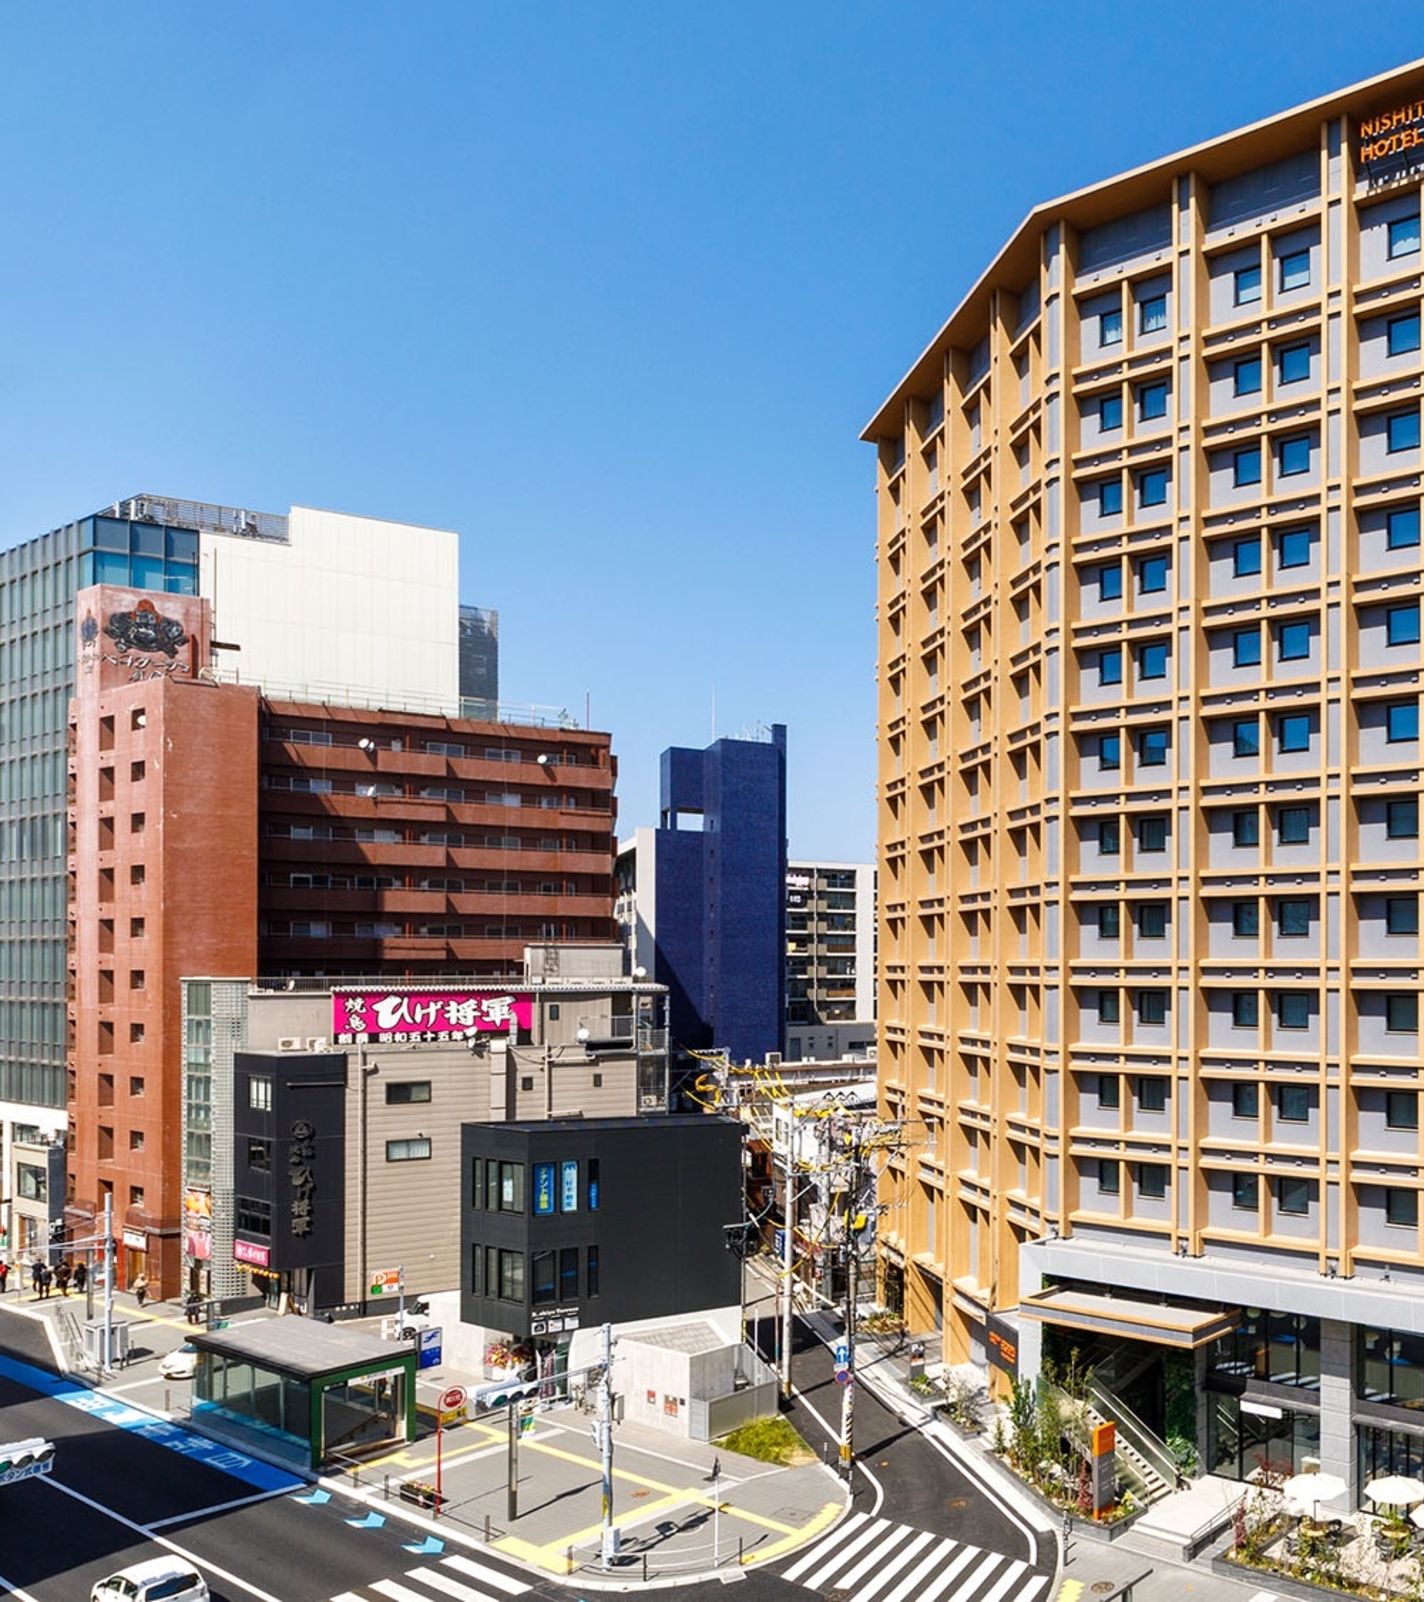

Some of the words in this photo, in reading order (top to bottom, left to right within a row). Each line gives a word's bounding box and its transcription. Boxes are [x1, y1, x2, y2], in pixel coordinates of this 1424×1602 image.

[1360, 127, 1424, 163] HOTEL
[371, 994, 516, 1029] ひげ将軍
[378, 1030, 464, 1044] 昭和五十五年
